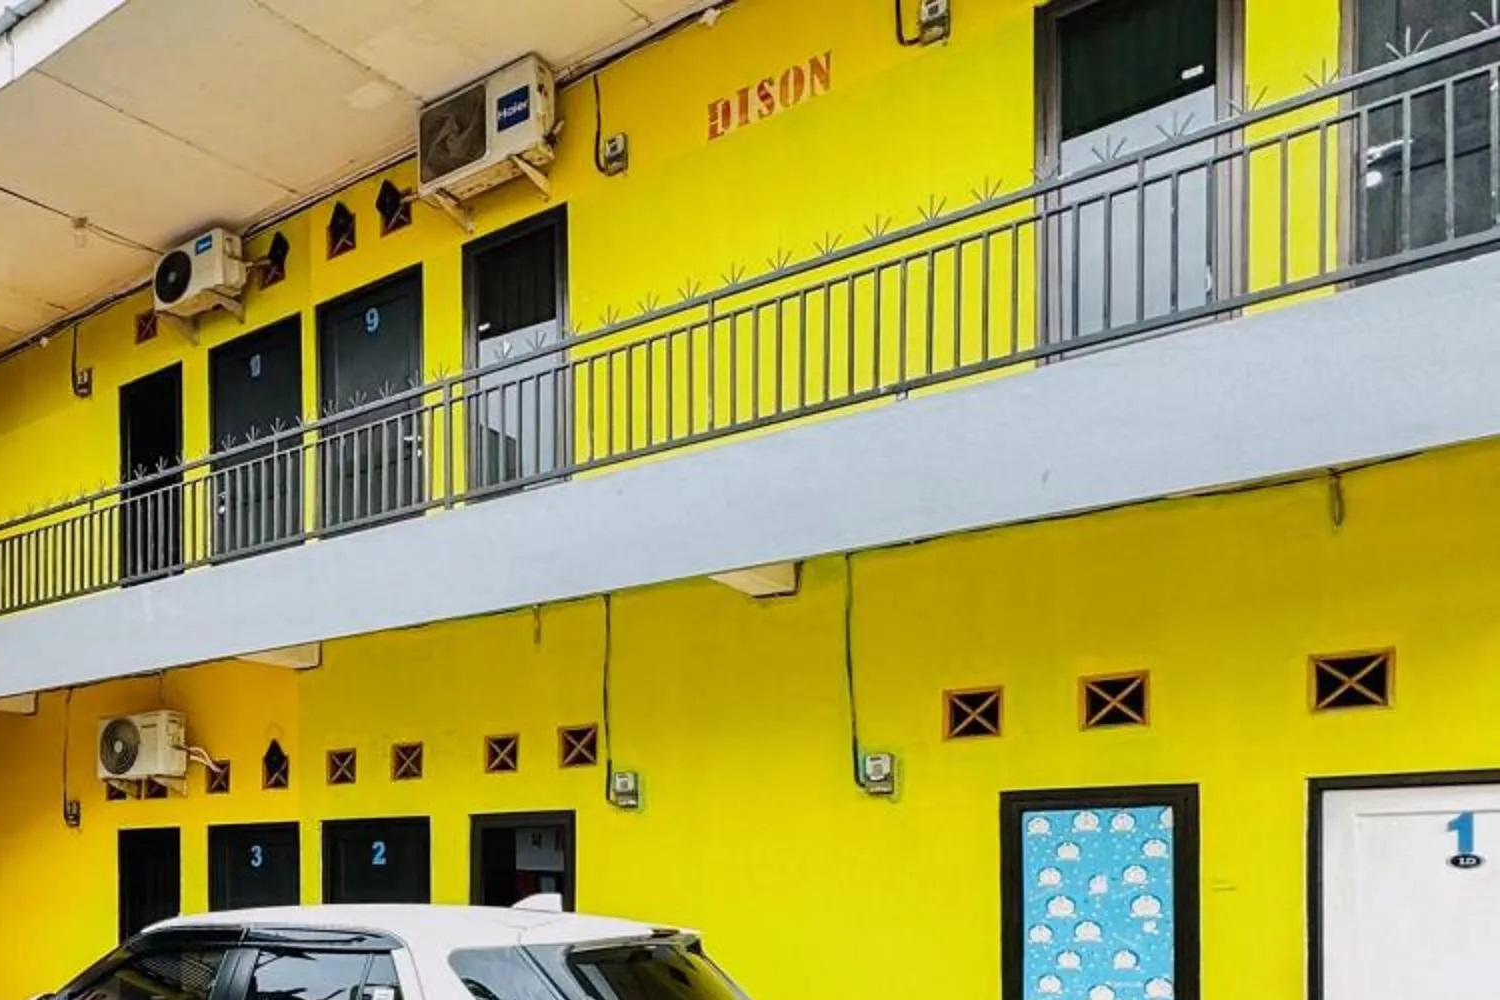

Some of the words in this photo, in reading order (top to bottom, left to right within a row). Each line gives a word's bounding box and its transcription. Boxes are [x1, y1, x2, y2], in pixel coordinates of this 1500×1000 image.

[708, 50, 833, 141] DISON
[365, 307, 379, 333] 9
[1446, 809, 1475, 853] 1
[250, 844, 263, 867] 3
[371, 840, 387, 865] 2
